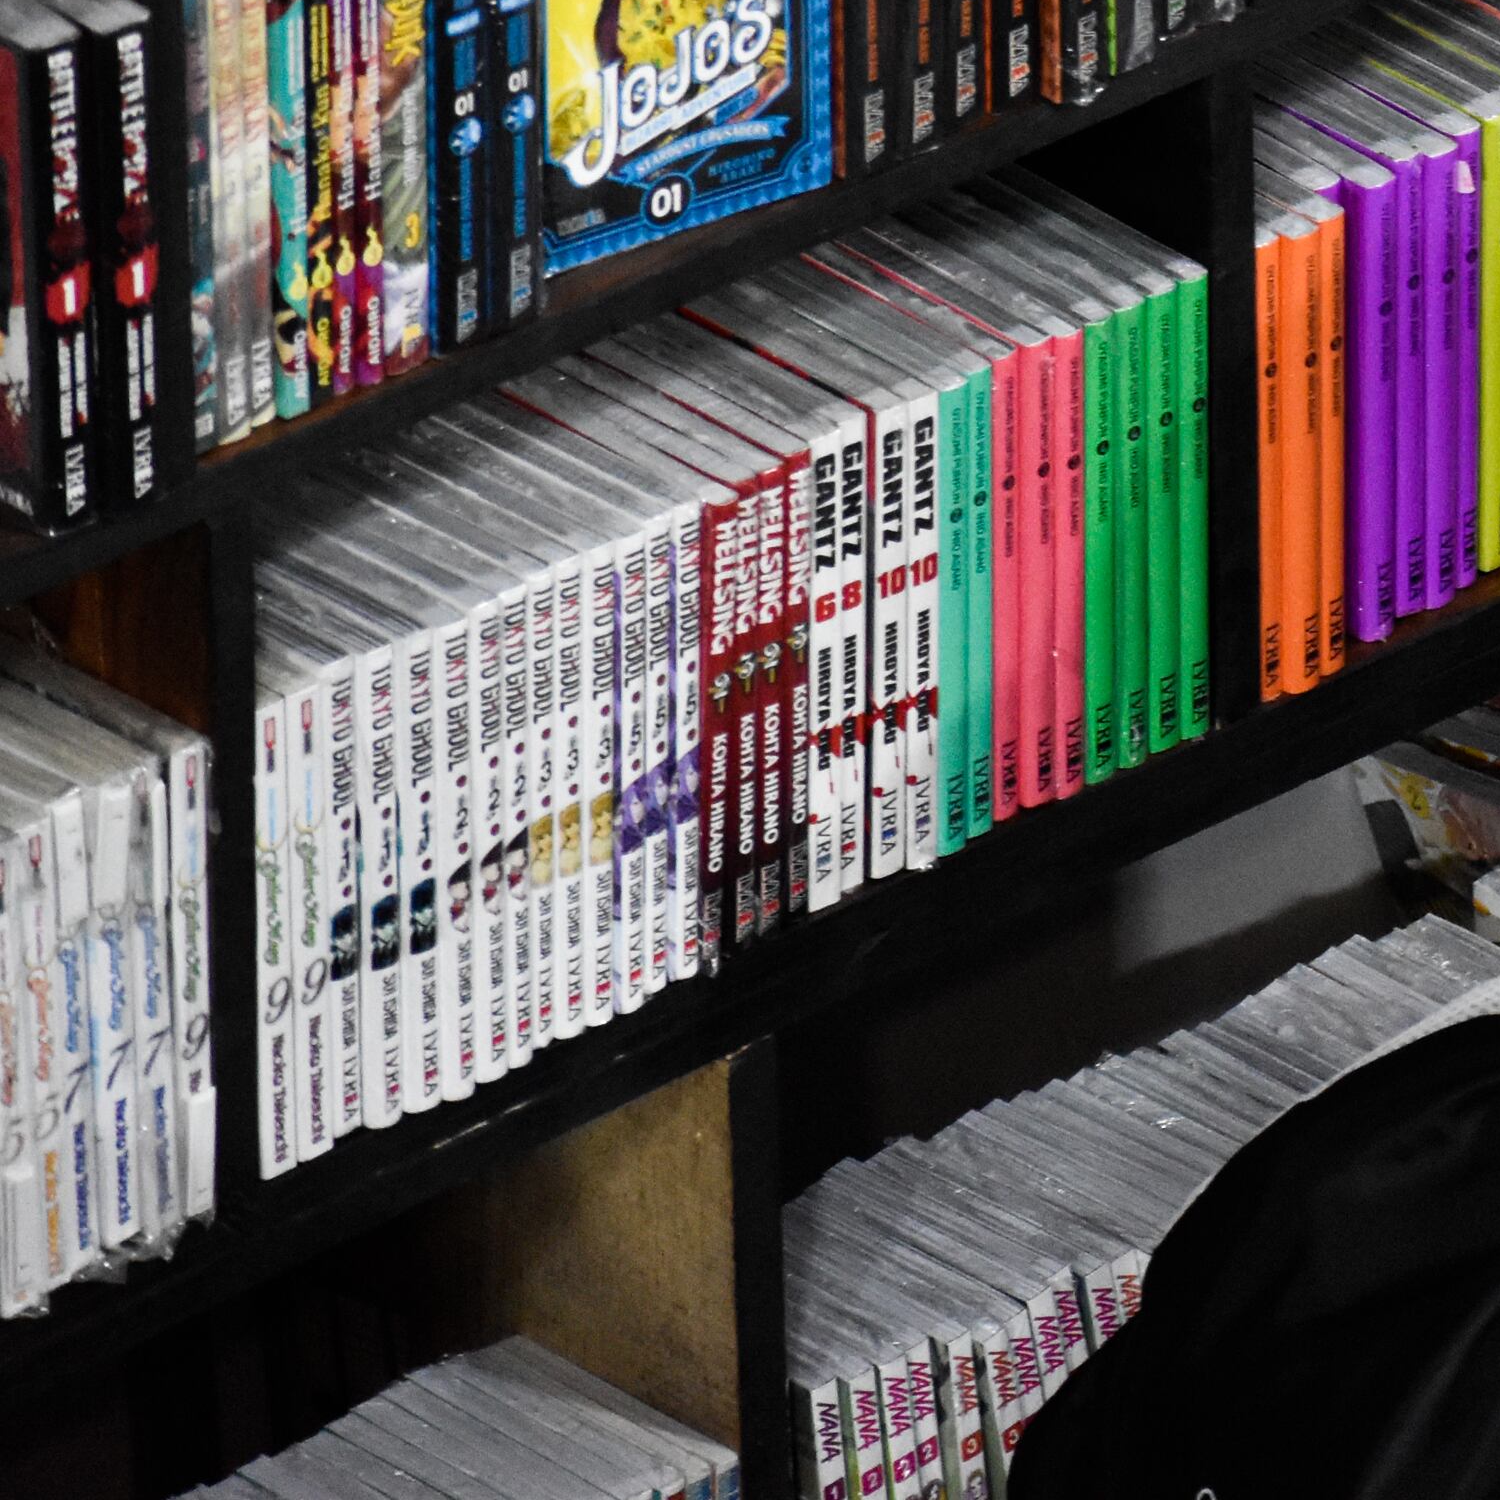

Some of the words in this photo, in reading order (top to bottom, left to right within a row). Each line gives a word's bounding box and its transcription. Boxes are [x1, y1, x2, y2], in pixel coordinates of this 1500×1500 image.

[404, 212, 420, 248] 3
[650, 182, 683, 219] 01
[63, 277, 76, 316] 1
[131, 260, 145, 299] 1
[338, 303, 353, 376] AIDAIRO
[367, 293, 382, 366] AIDAIRO
[815, 452, 837, 574] GANTZ
[841, 439, 864, 563] GANTZ
[882, 427, 905, 550] GANTZ
[711, 520, 738, 656] HELLSING
[759, 488, 785, 626] HELLSING
[876, 564, 908, 601] 10
[560, 573, 580, 638] TOKYO
[813, 593, 838, 625] 6
[840, 579, 863, 612] 8
[446, 632, 467, 698] TOKYO
[560, 641, 580, 713] GHOUL
[884, 620, 899, 701] HIROYA
[1304, 612, 1319, 679] IVREA
[448, 700, 471, 773] GHOUL
[1161, 671, 1176, 739] IVREA
[711, 732, 728, 791] KOHTA
[974, 755, 989, 825] IVREA
[707, 792, 726, 874] HIRANO
[302, 956, 326, 1004] 9
[423, 1028, 439, 1097] IVREA
[884, 1377, 912, 1439] NANA
[907, 1361, 935, 1422] NANA
[953, 1355, 978, 1417] NANA
[816, 1402, 843, 1463] NANA
[854, 1389, 880, 1451] NANA
[922, 1442, 933, 1460] 2
[868, 1473, 879, 1490] 2
